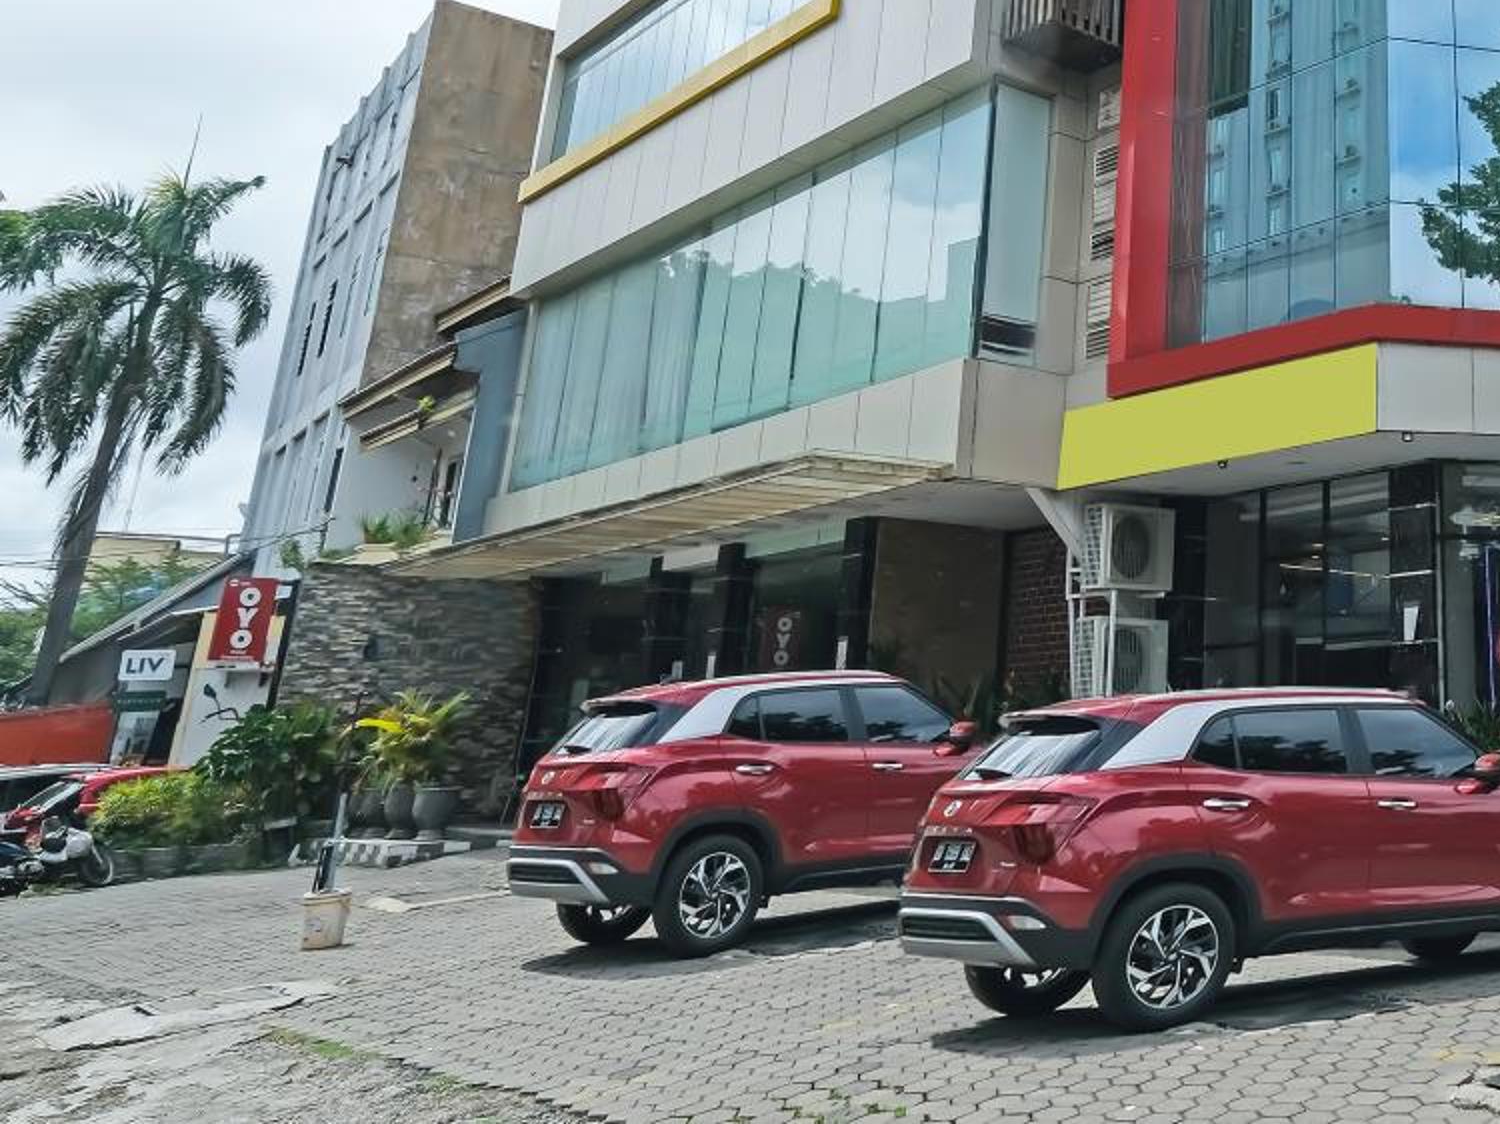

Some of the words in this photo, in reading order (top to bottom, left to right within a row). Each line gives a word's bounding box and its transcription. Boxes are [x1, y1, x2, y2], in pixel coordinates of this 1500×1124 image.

[229, 587, 262, 650] OYO
[773, 617, 793, 666] OYO
[126, 656, 165, 675] LIV
